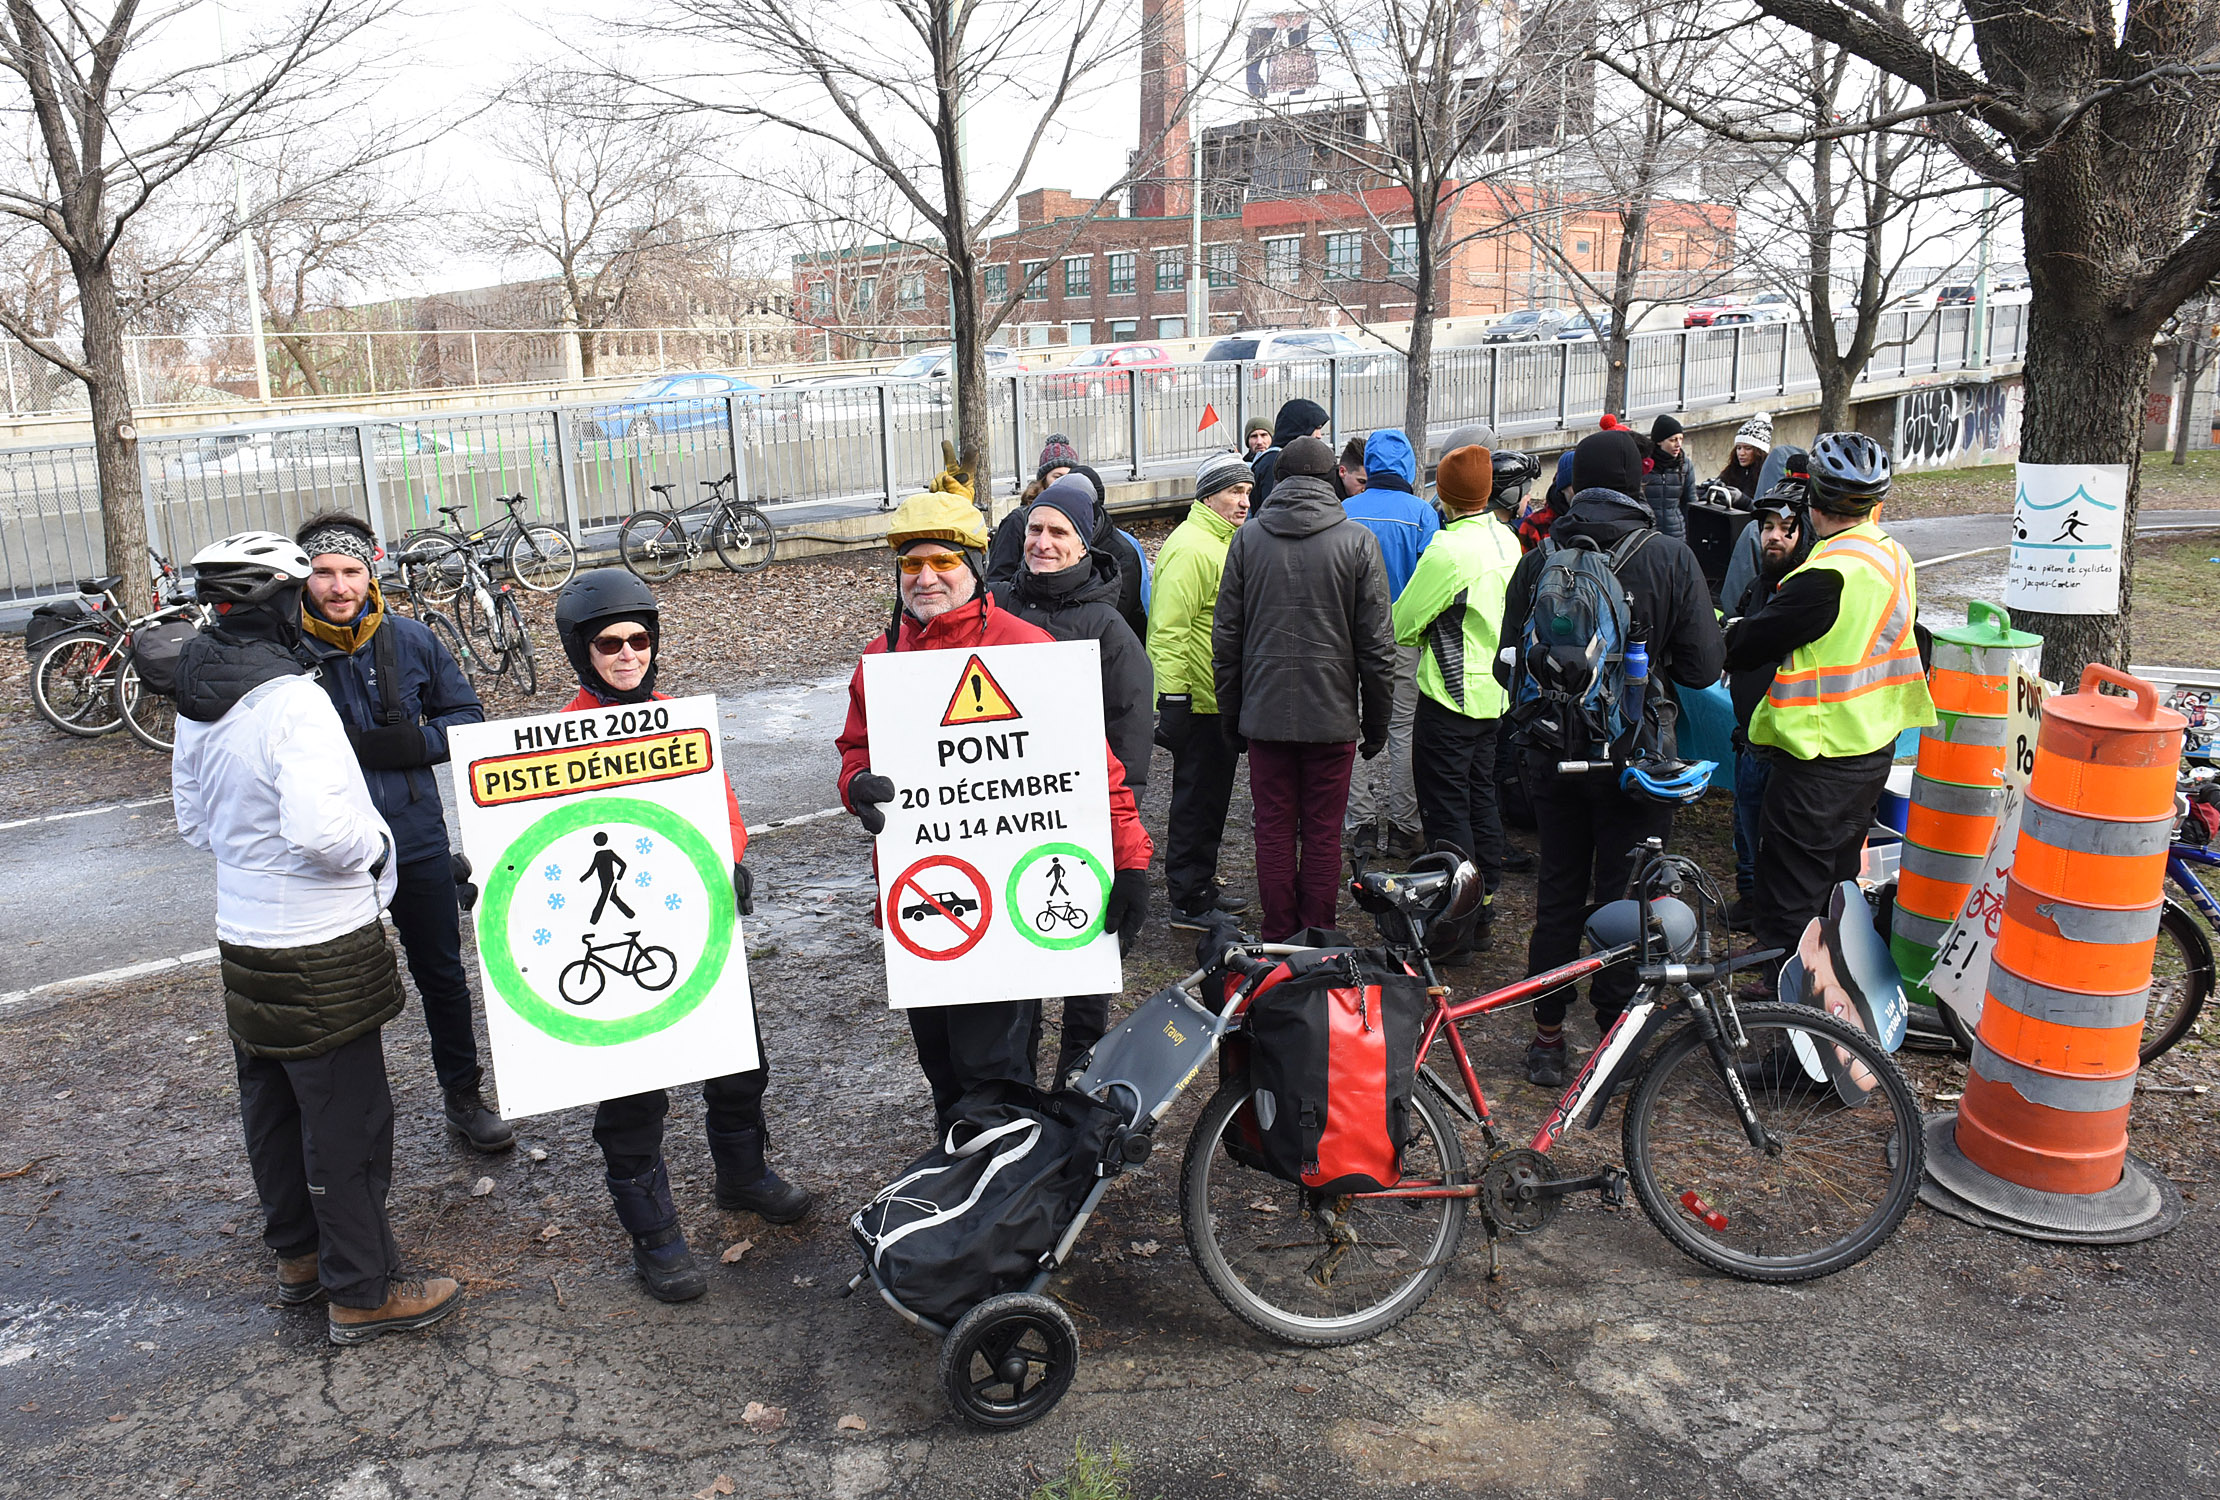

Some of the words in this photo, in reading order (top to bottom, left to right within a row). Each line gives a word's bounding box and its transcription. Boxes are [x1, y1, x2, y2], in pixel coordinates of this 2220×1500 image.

[2067, 565, 2077, 573] et
[2078, 563, 2113, 577] cyclistes
[515, 718, 598, 750] HIVER
[604, 707, 669, 737] 2020
[484, 763, 561, 795] PISTE
[567, 737, 698, 784] DÉNEIGÉE
[937, 731, 1030, 767] PONT
[899, 787, 930, 809] 20
[915, 821, 951, 844] AU
[959, 818, 989, 839] 14
[995, 809, 1068, 836] AVRIL
[1162, 1020, 1187, 1047] Travoy
[1174, 1065, 1199, 1091] Travoy
[1546, 1022, 1624, 1140] NOR
[1726, 1067, 1751, 1111] ZOOM
